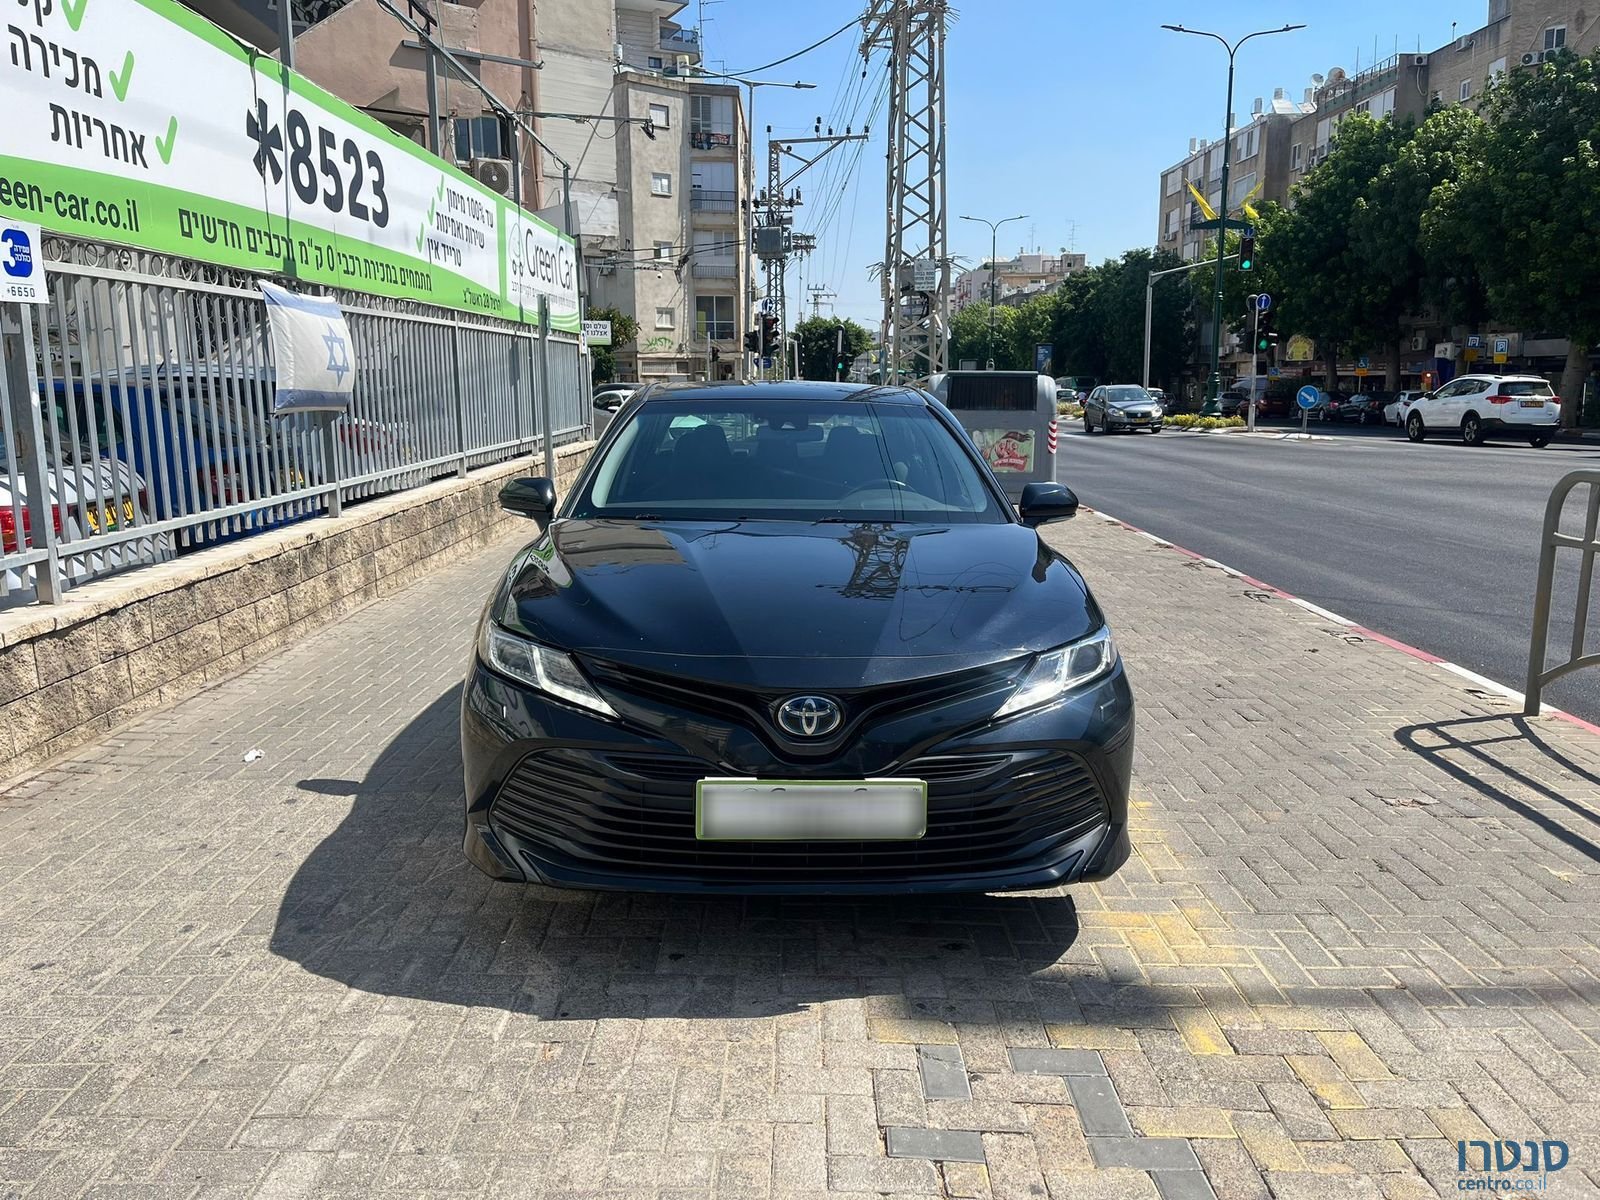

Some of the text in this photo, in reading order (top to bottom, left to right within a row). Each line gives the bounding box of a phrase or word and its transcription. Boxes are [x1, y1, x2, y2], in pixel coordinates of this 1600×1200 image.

[8, 24, 102, 98] מכירה
[49, 102, 148, 168] אחריות
[446, 187, 494, 228] עד 100% מימון
[178, 208, 242, 250] חדשים
[245, 226, 295, 261] ורכבים
[435, 211, 485, 249] שירות ואמינות
[337, 252, 362, 277] רכבי
[427, 237, 441, 264] אין
[364, 259, 398, 284] במכירת
[399, 267, 432, 291] מתמחים
